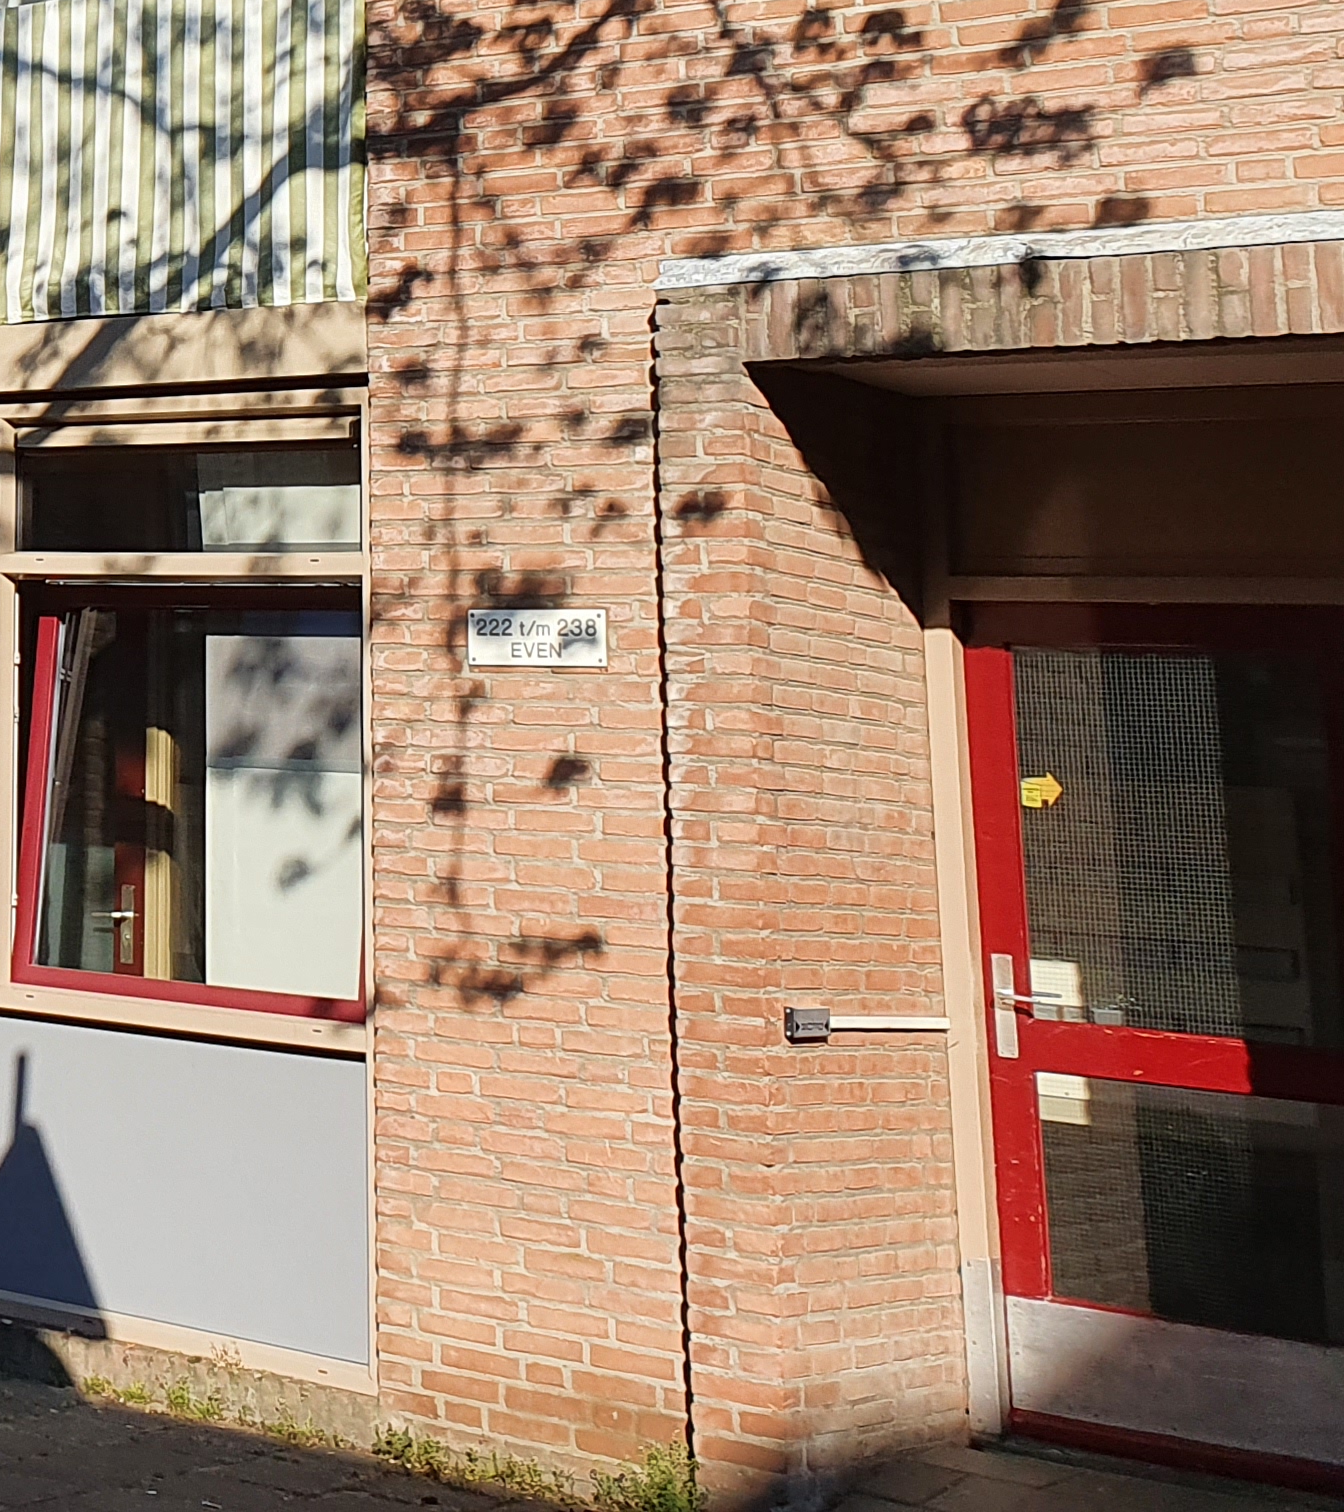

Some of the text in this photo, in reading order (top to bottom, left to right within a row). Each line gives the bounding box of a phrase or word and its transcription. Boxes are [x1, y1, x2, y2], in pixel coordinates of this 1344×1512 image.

[476, 618, 598, 637] 222 t/m 238
[511, 642, 563, 659] EVEN
